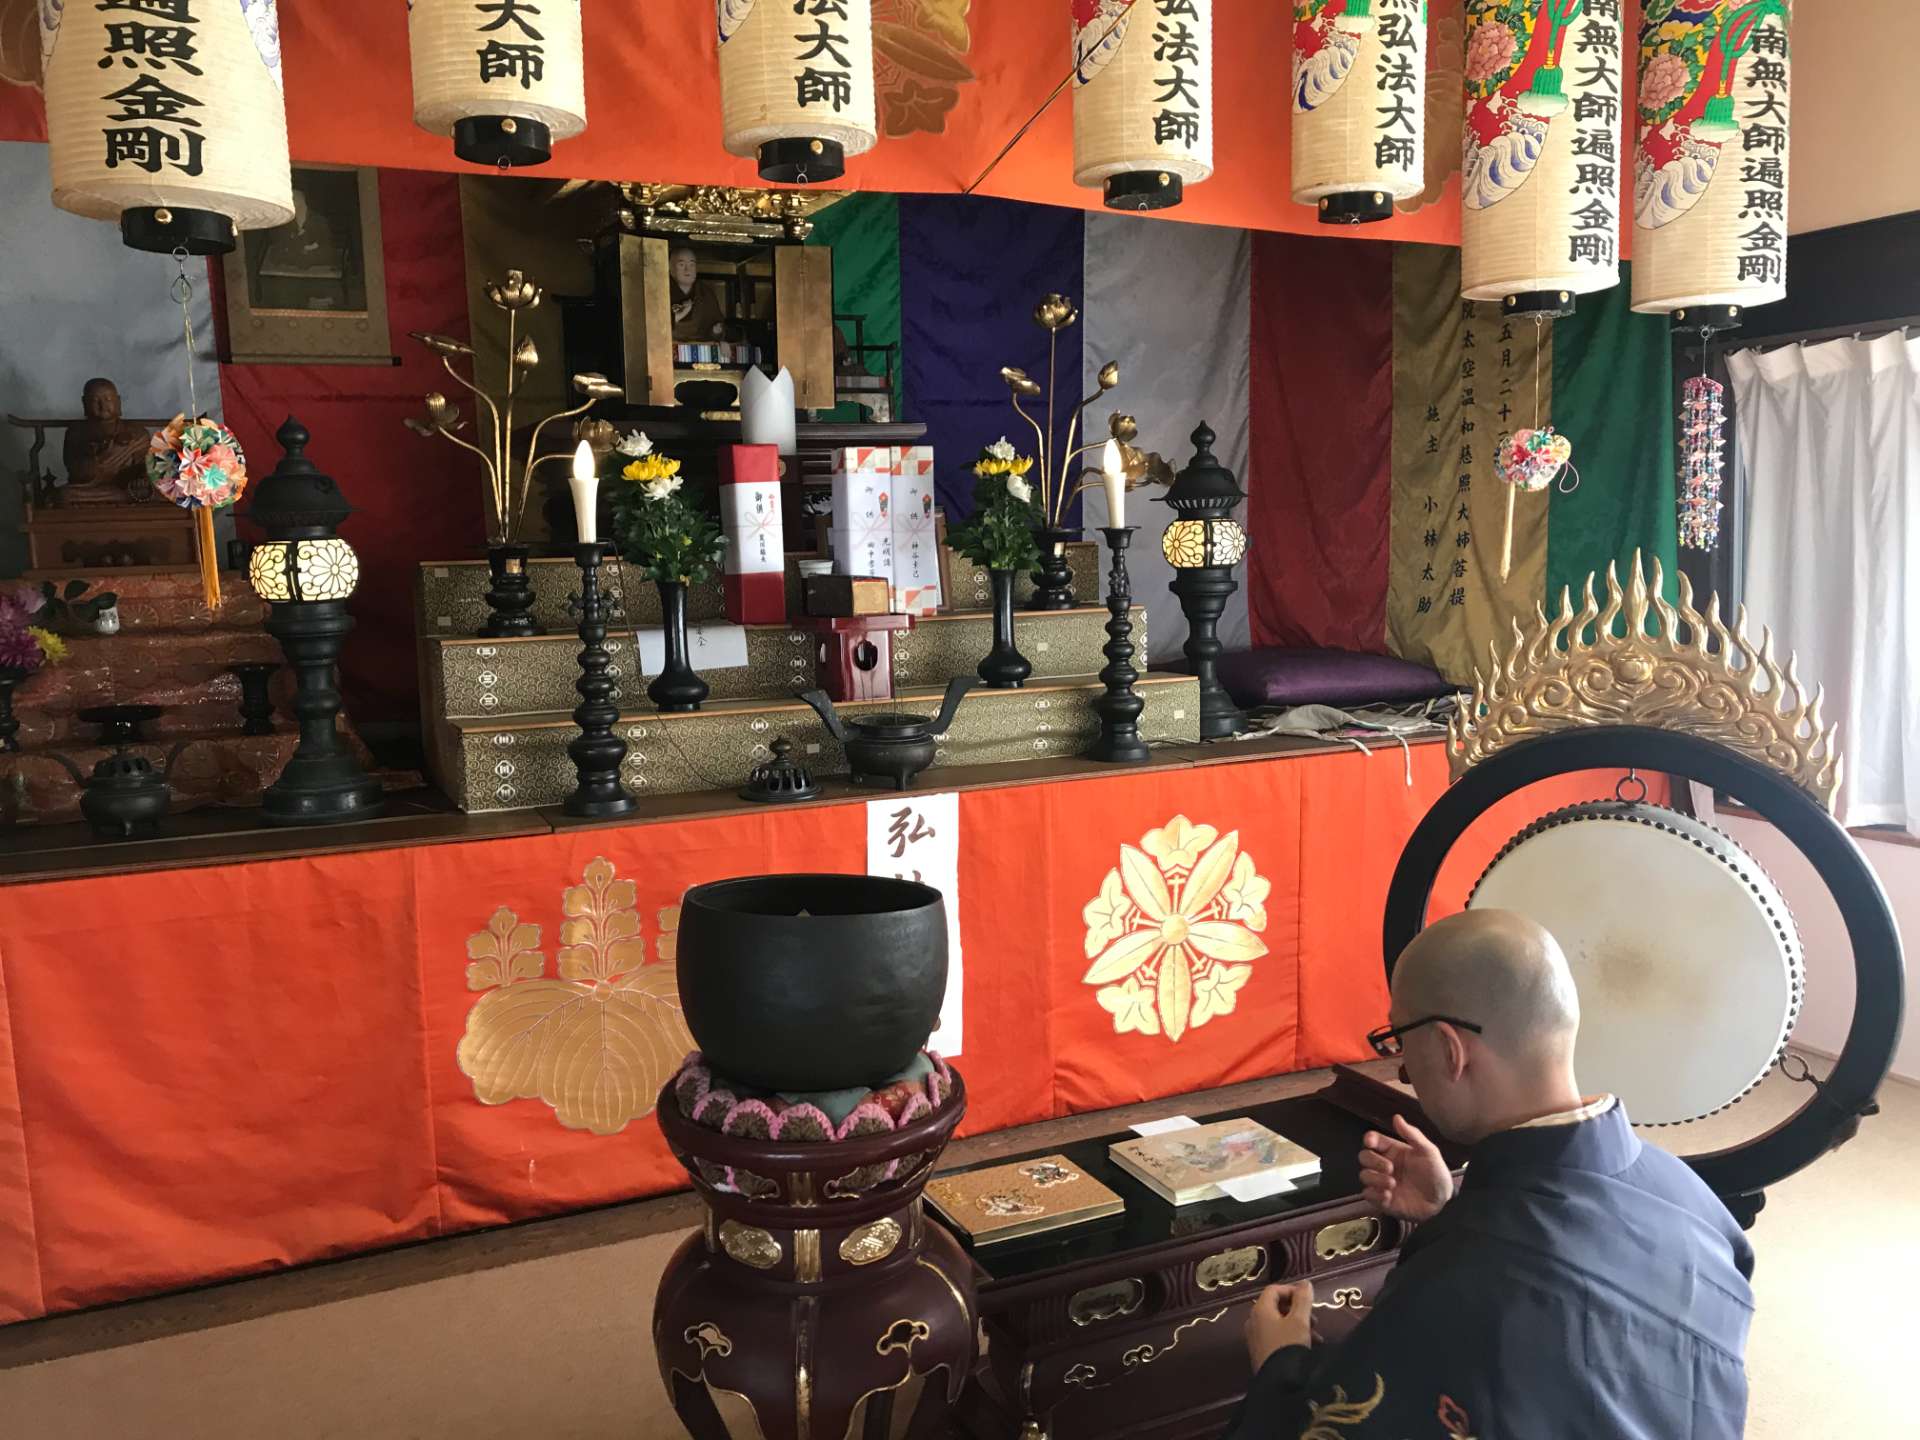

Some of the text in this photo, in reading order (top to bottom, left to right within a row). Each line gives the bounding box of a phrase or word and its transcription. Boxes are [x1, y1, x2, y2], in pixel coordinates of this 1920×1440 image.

[1374, 0, 1418, 172] 弘法大師
[1736, 24, 1788, 285] 南無大師遍照金剛
[887, 806, 936, 885] 弘
